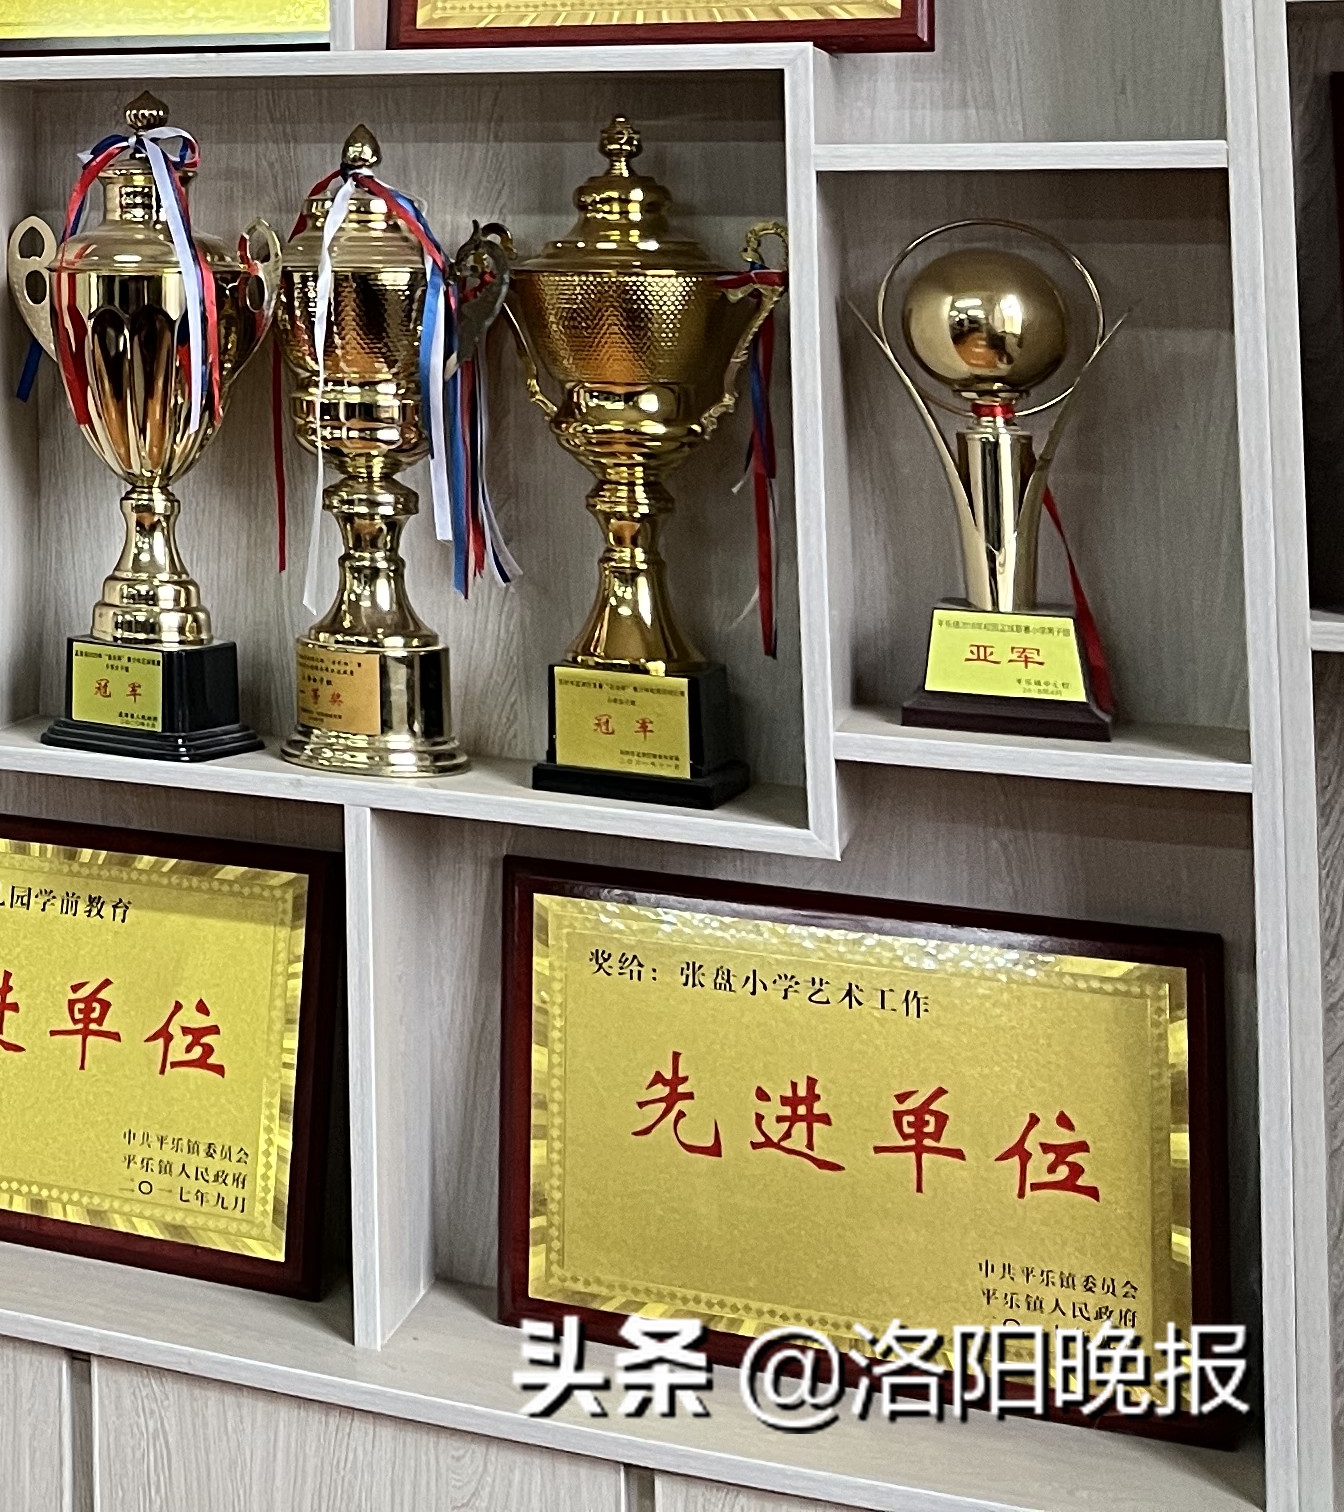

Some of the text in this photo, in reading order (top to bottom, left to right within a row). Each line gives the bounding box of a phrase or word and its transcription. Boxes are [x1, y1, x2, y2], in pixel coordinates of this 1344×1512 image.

[964, 644, 1045, 669] 亚军
[94, 678, 142, 704] 冠军
[593, 713, 654, 742] 冠军
[589, 948, 931, 1019] 奖给：张盘小学艺术工作
[631, 1050, 1101, 1203] 先进单位
[122, 1127, 250, 1166] 中共平乐镇委员会
[122, 1153, 248, 1191] 平乐镇人民政府
[977, 1258, 1140, 1301] 中共平乐镇委员会
[981, 1287, 1139, 1330] 平乐镇人民政府
